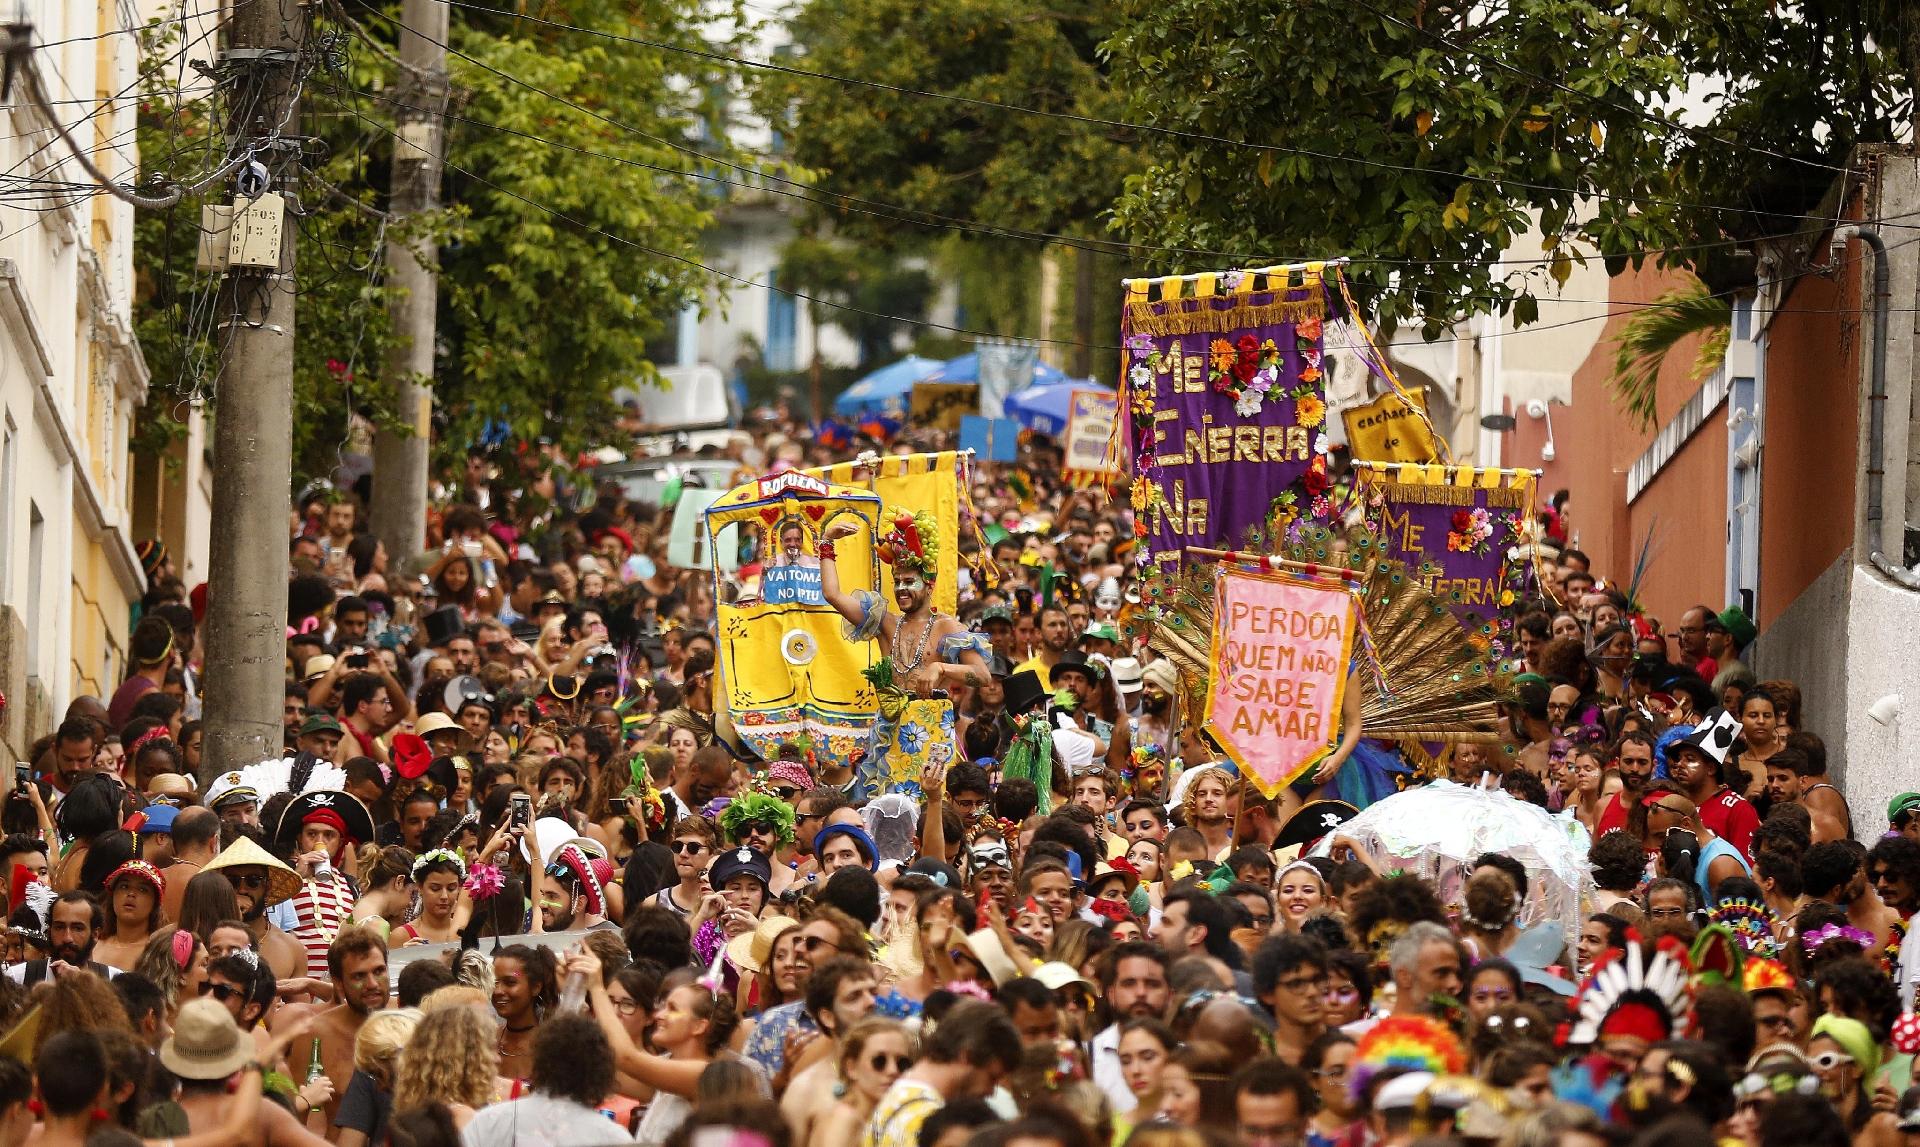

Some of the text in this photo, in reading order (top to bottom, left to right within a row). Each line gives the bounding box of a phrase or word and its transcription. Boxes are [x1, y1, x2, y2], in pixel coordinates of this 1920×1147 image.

[1152, 408, 1310, 467] ENERRA
[1384, 438, 1399, 451] de
[1382, 506, 1425, 553] ME
[767, 570, 787, 582] VAI
[778, 587, 820, 601] NO IPTU
[1231, 602, 1342, 642] PERDOA
[1301, 649, 1338, 675] NÃO
[1234, 674, 1316, 710] SABE
[1231, 705, 1321, 742] AMAR
